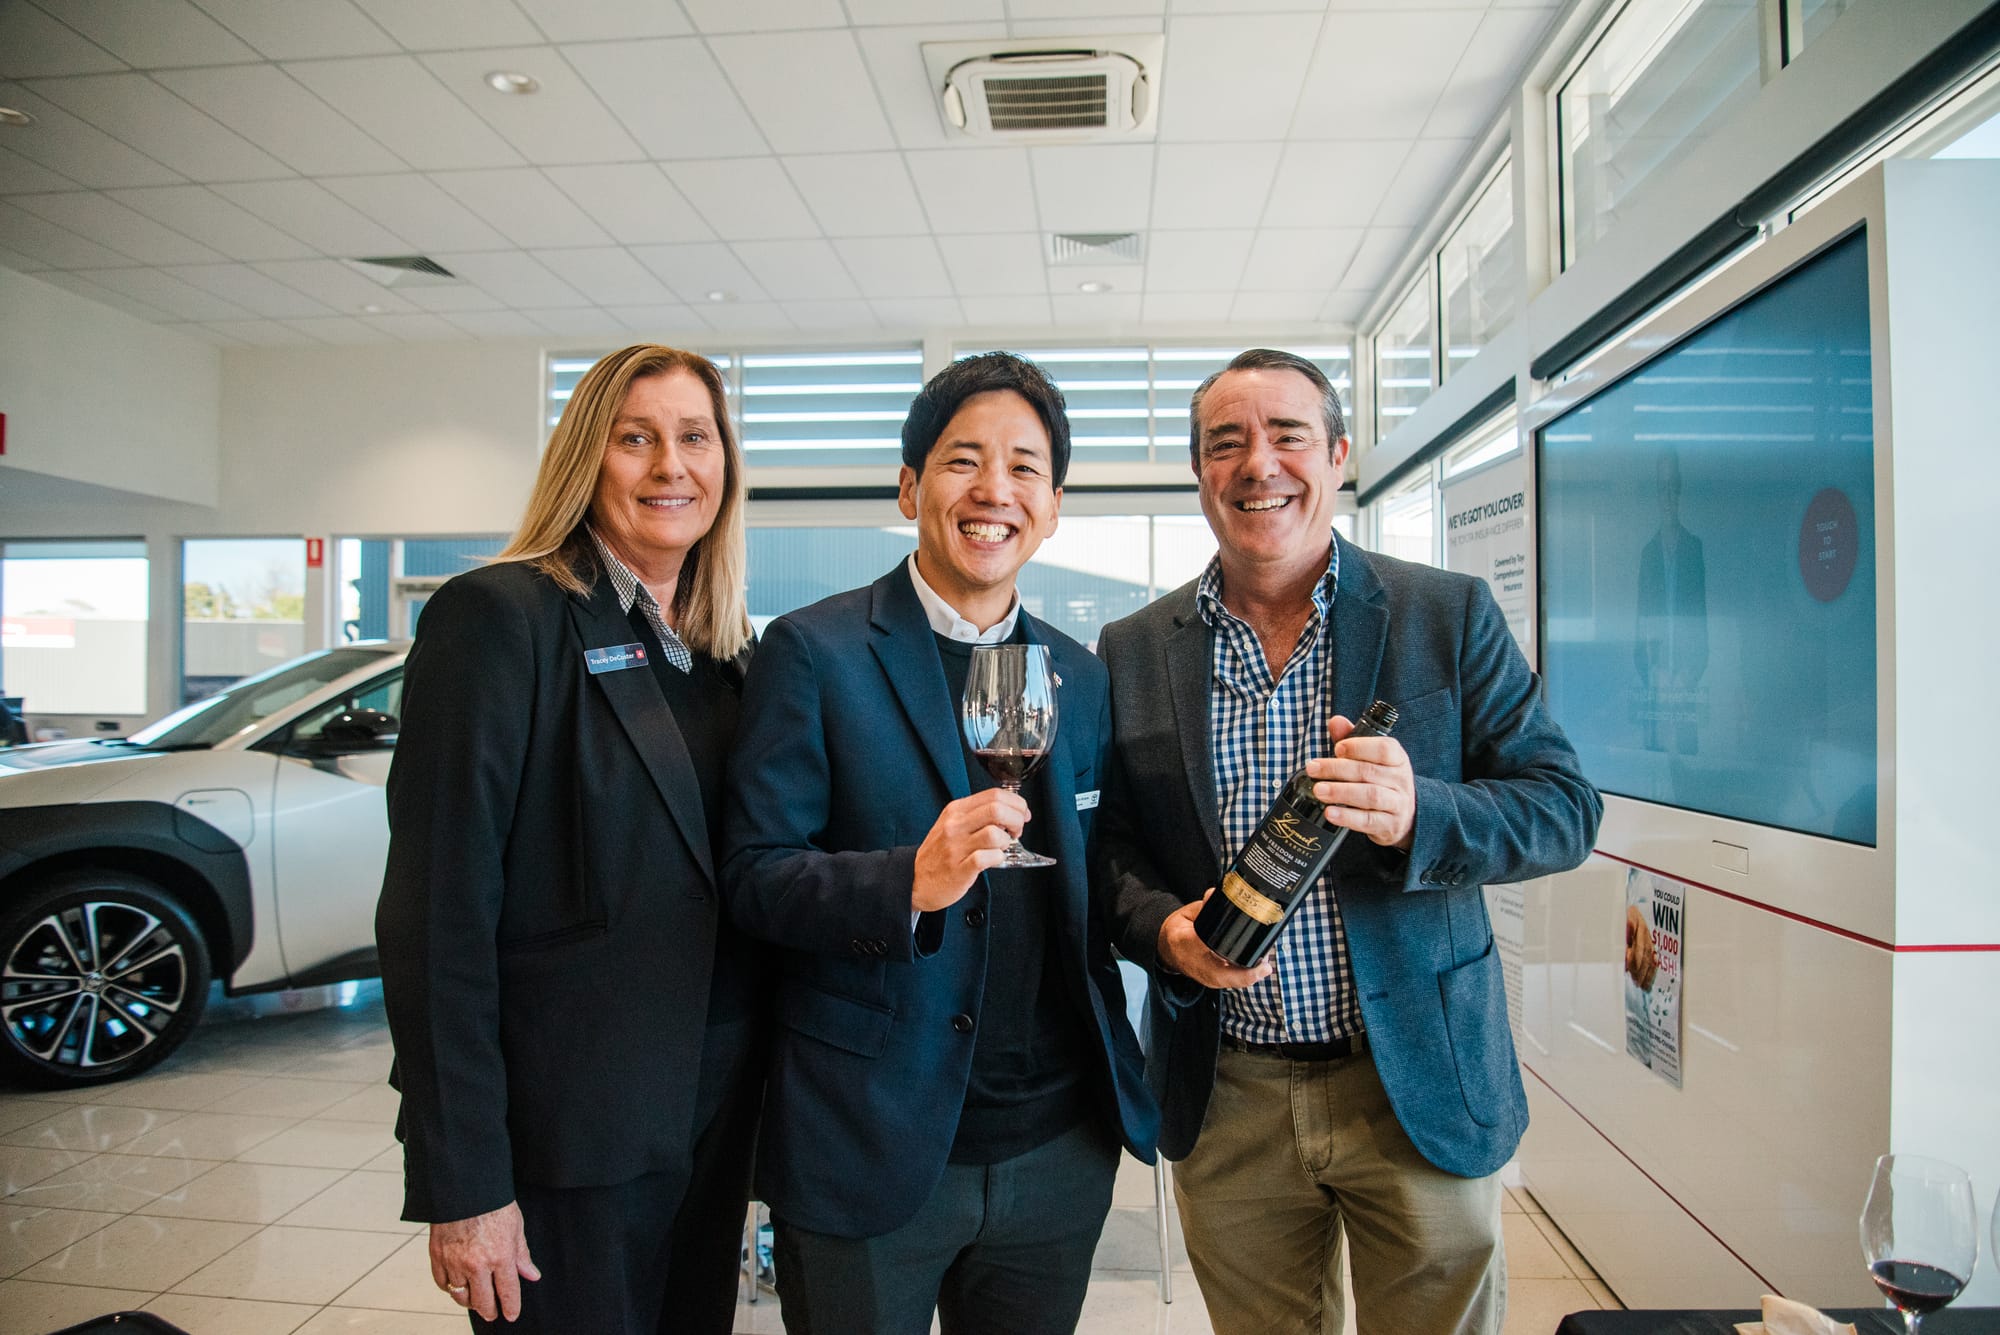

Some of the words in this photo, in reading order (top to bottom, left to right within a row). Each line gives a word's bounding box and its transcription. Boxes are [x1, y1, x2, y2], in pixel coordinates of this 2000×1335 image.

[1467, 506, 1482, 524] GOT
[1482, 500, 1498, 519] YOU
[1268, 840, 1294, 860] FREEDOM
[1294, 857, 1308, 868] 1843
[1274, 851, 1290, 864] SHIRAZ
[1654, 888, 1664, 900] YOU
[1663, 892, 1680, 905] COULD
[1652, 900, 1679, 935] WIN
[1652, 929, 1679, 956] $1,000
[1651, 951, 1677, 977] CASH!
